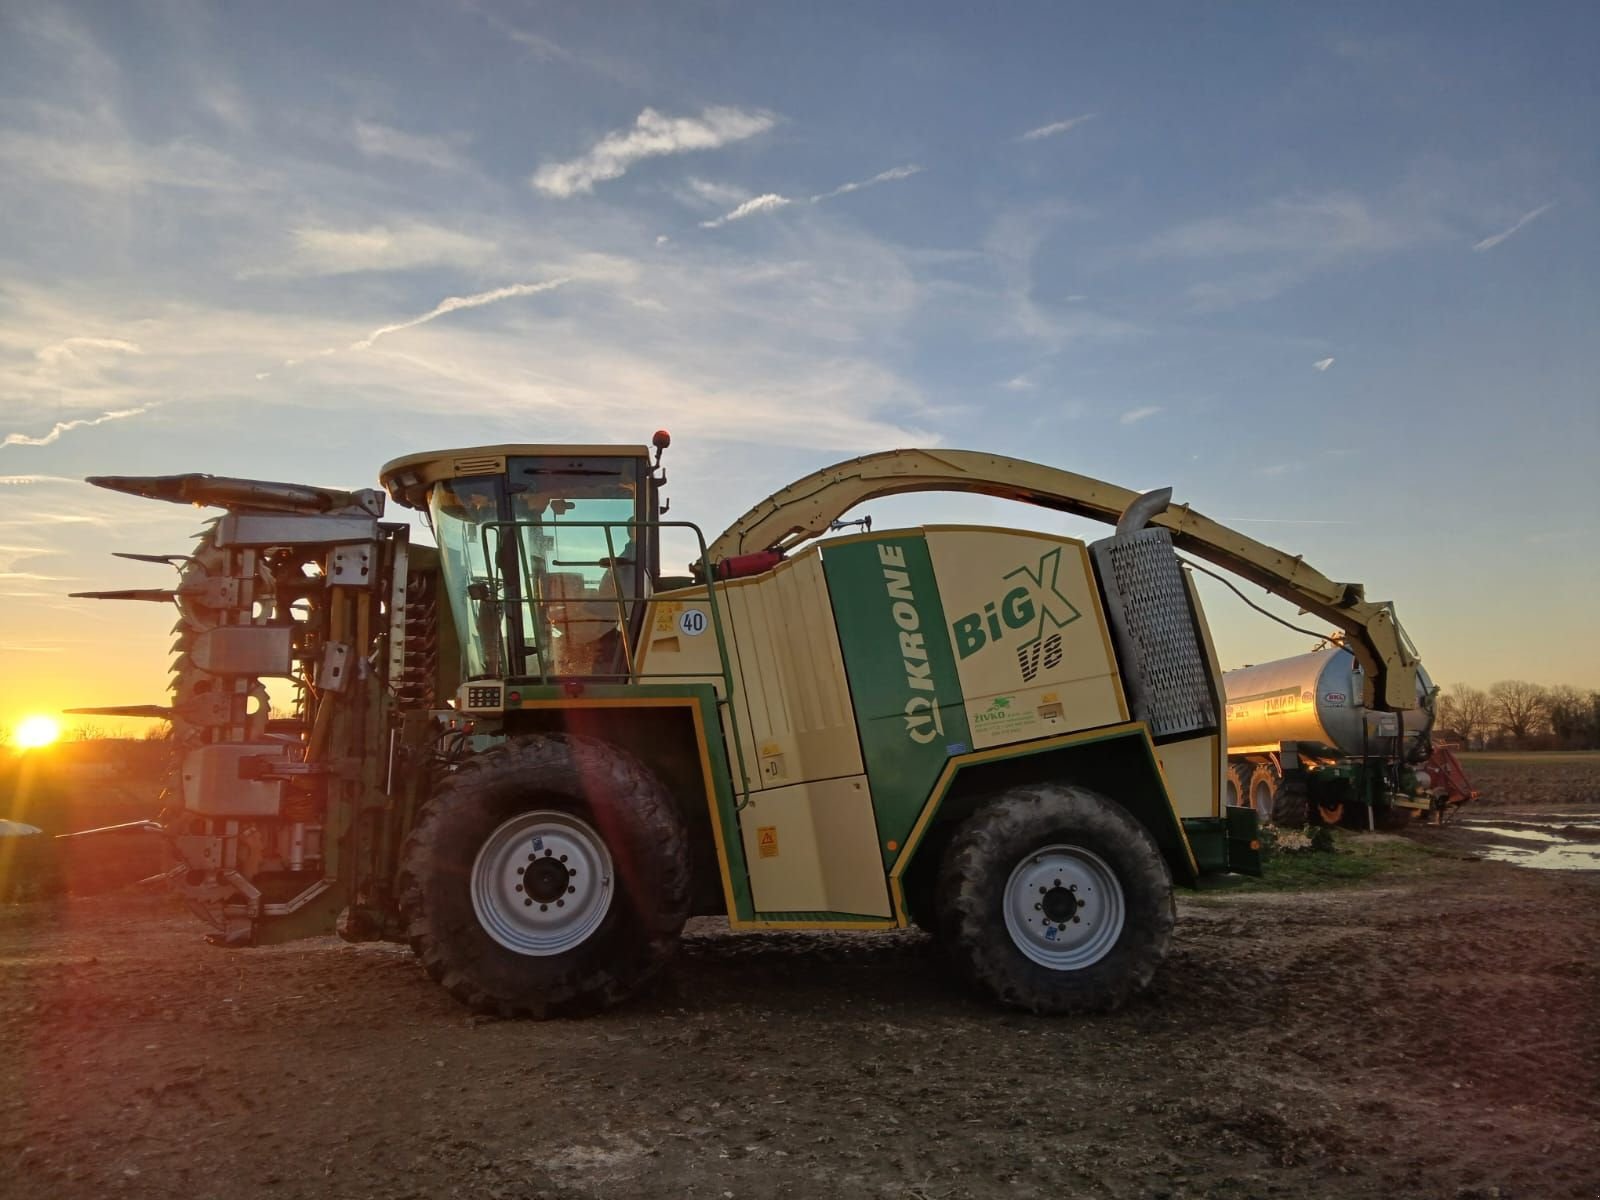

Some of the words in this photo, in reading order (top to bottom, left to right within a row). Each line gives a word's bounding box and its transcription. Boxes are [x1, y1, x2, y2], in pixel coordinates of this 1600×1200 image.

[683, 613, 703, 631] 40
[877, 543, 935, 691] KRONE
[1017, 633, 1063, 683] V8
